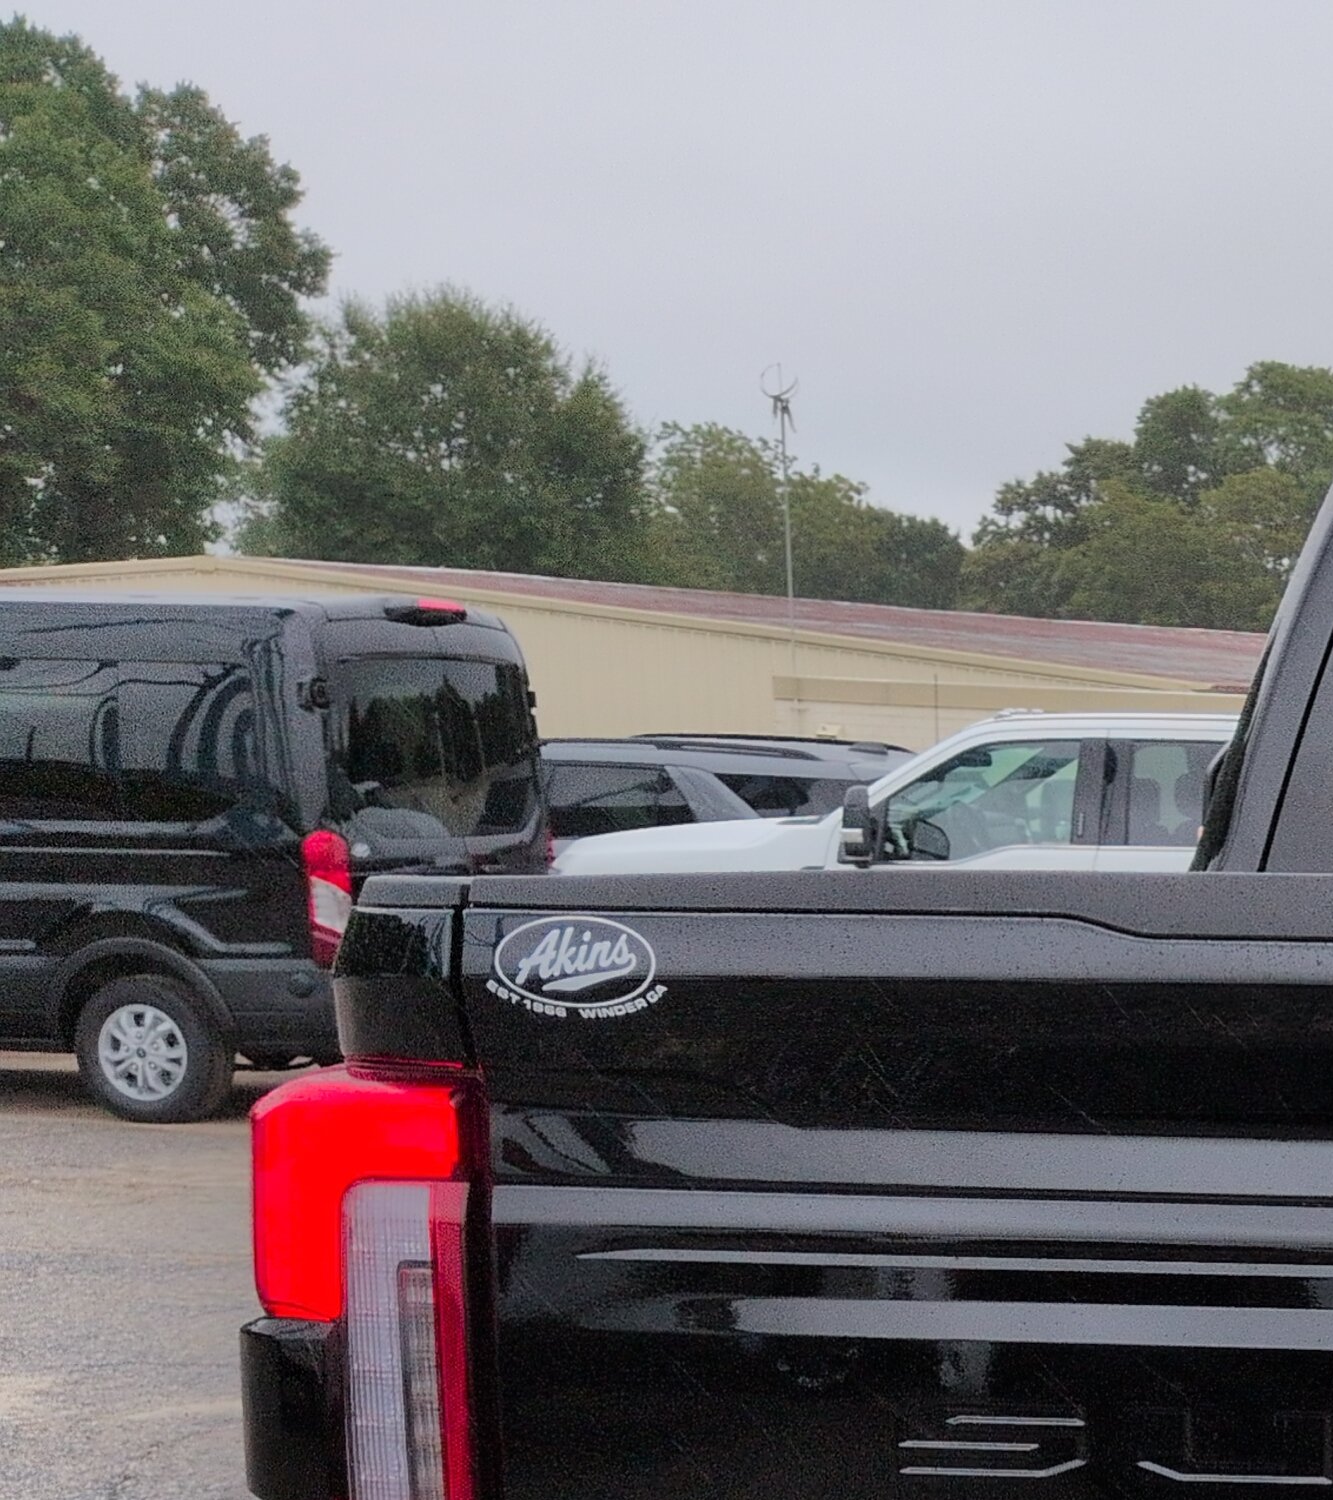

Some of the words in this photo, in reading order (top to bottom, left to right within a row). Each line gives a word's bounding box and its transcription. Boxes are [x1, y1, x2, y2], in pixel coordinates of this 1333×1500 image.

[515, 927, 637, 988] Akins
[486, 979, 521, 1004] EST
[578, 997, 648, 1019] WINDER
[645, 984, 668, 1003] GA
